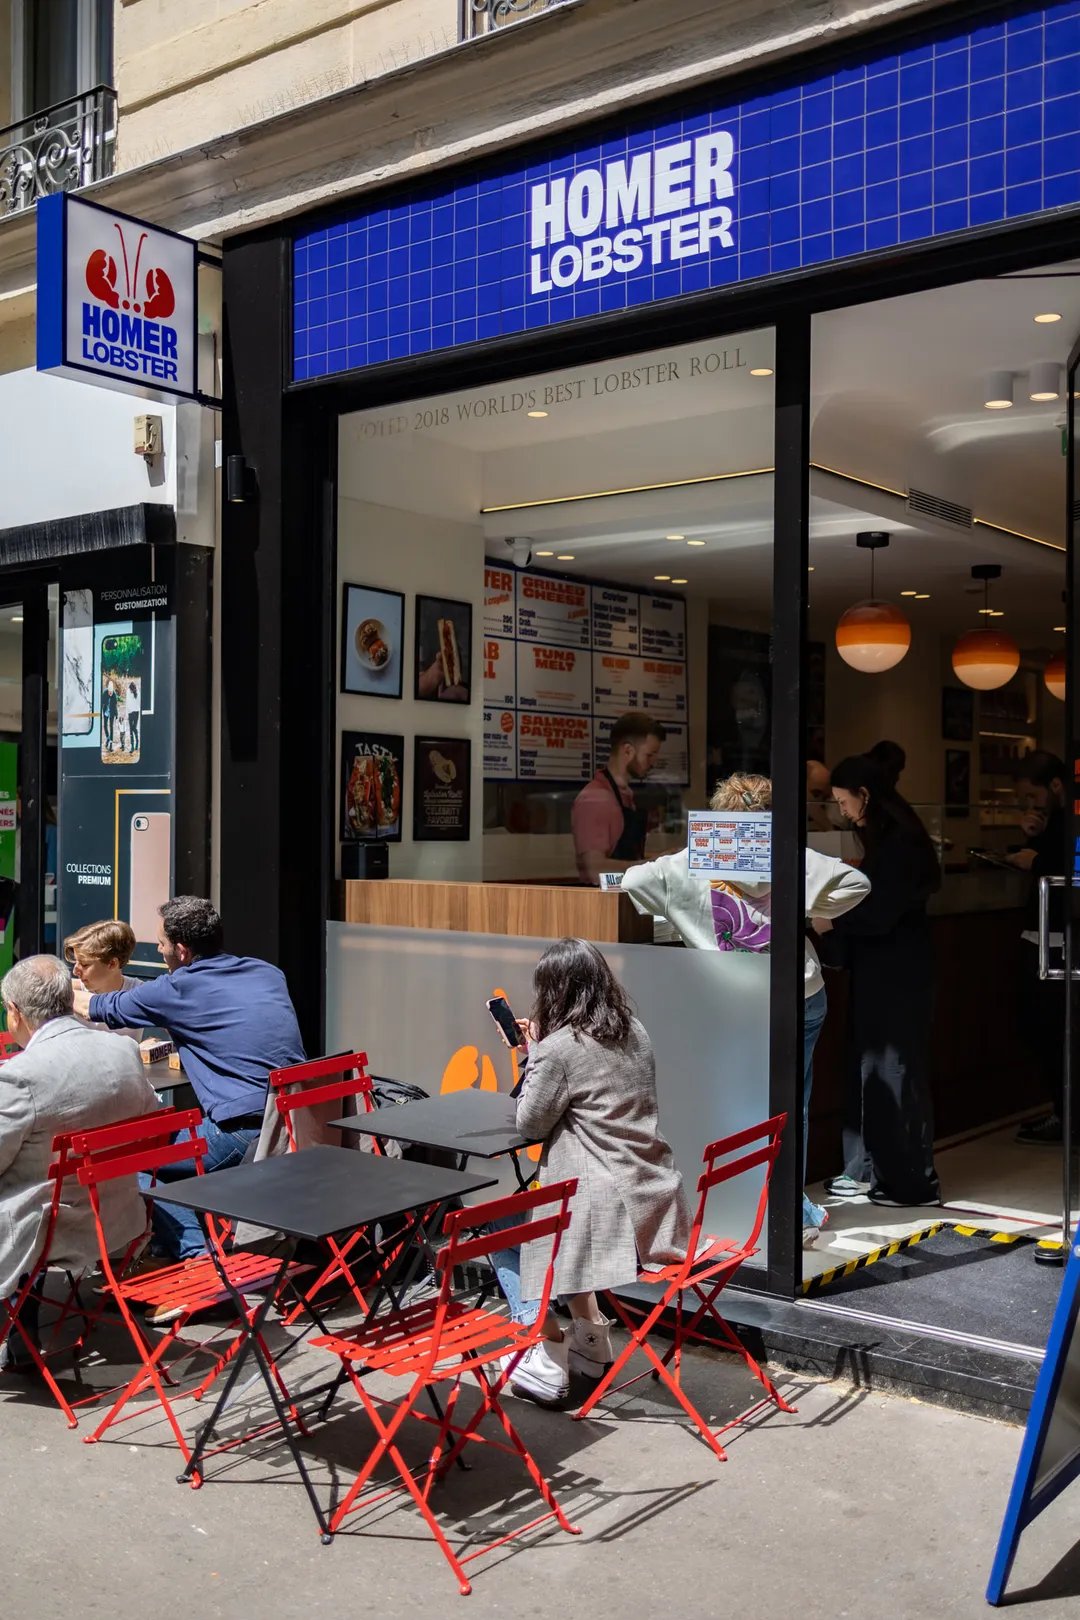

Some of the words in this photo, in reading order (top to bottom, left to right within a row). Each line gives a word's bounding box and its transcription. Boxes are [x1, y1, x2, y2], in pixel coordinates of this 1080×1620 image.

[531, 131, 735, 250] HOMER
[531, 206, 735, 294] LOBSTER
[83, 302, 178, 359] HOMER
[83, 338, 178, 382] LOBSTER
[414, 407, 450, 430] 2018
[457, 389, 537, 421] WORLD'S
[544, 380, 586, 406] BEST
[593, 361, 680, 395] LOBSTER
[690, 348, 747, 377] ROLL
[100, 584, 168, 601] PERSONNALISATION
[522, 576, 586, 597] GRILLED
[114, 597, 168, 611] CUSTOMIZATION
[523, 588, 585, 607] CHEESE
[533, 647, 576, 662] TUNA
[535, 658, 575, 672] MELT
[521, 715, 588, 730] SALMON
[520, 726, 590, 740] PASTRA-
[546, 738, 565, 749] MI
[66, 863, 112, 875] COLLECTIONS
[78, 875, 112, 886] PREMIUM
